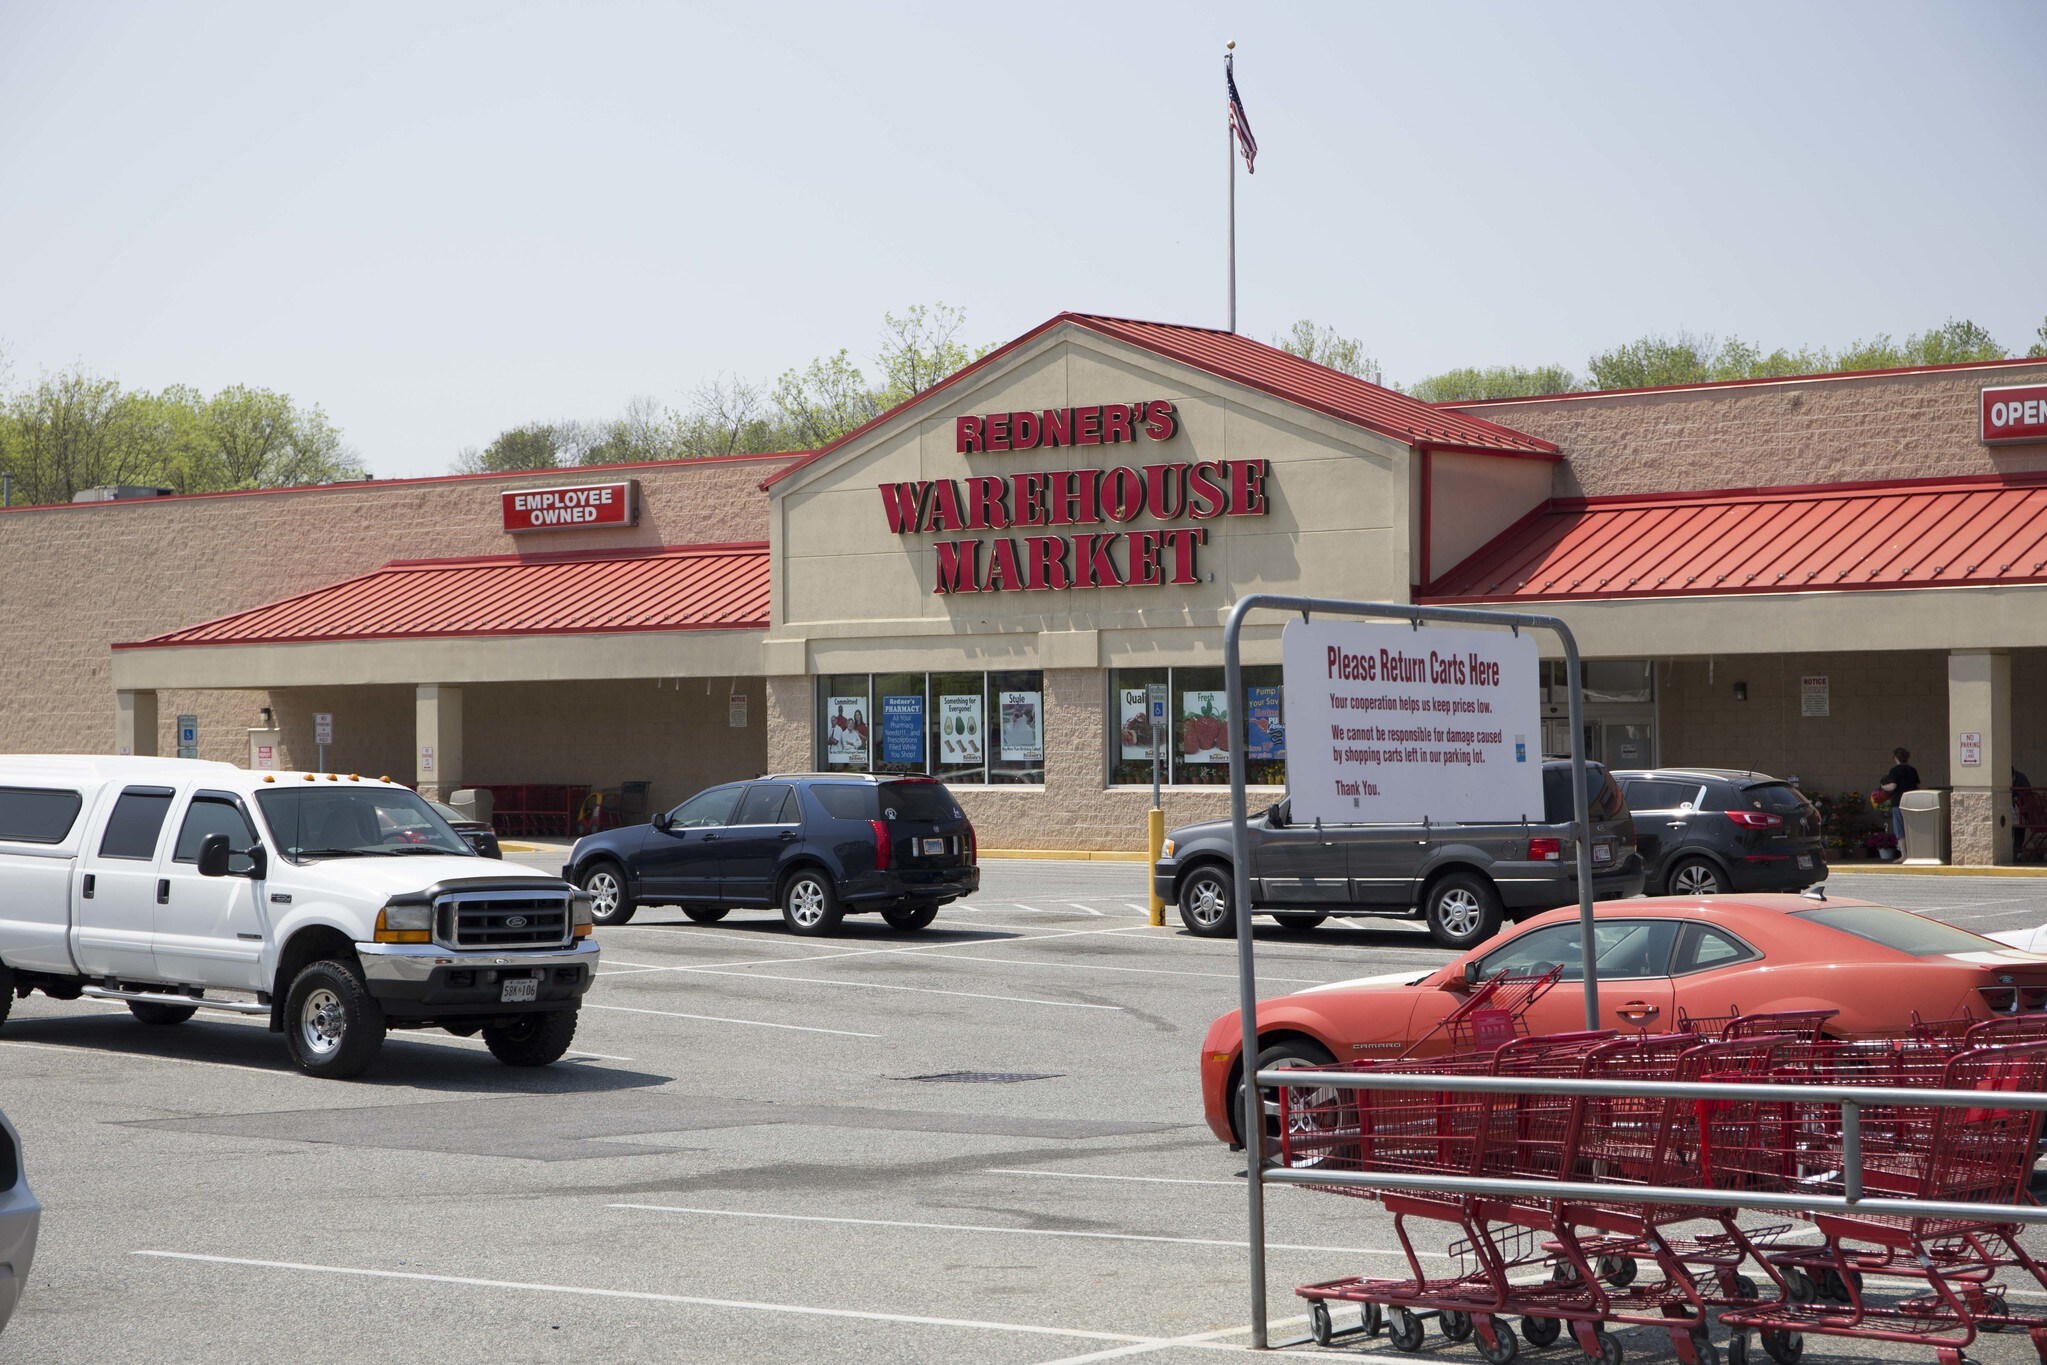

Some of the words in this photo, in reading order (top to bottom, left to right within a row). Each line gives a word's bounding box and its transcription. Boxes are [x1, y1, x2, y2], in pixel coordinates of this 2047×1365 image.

[956, 399, 1176, 454] REDNER'S
[515, 489, 612, 511] EMPLOYEE
[878, 458, 1270, 534] WAREHOUSE
[531, 507, 597, 525] OWNED
[933, 527, 1208, 595] MARKET
[1327, 645, 1377, 682] Please
[1380, 648, 1426, 684] Return
[1430, 650, 1466, 686] Carts
[1469, 653, 1500, 687] Here
[1008, 693, 1026, 704] Style
[1126, 691, 1146, 705] Qual
[1197, 693, 1215, 702] Fresh
[1256, 688, 1276, 696] Pump
[834, 698, 859, 706] Committed
[885, 705, 920, 713] PHARMACY
[944, 697, 969, 706] Something
[948, 705, 972, 713] Everyone!
[1249, 699, 1265, 708] Your
[1266, 697, 1279, 705] Sav
[1329, 693, 1348, 709] Your
[1350, 695, 1398, 713] cooperation
[1399, 696, 1420, 714] helps
[1422, 700, 1431, 711] us
[1432, 697, 1451, 716] keep
[1452, 698, 1475, 716] prices
[1477, 698, 1493, 714] low.
[1331, 724, 1345, 741] We
[1346, 726, 1374, 741] cannot
[1376, 725, 1386, 741] be
[1388, 726, 1432, 745] responsible
[1433, 727, 1445, 742] for
[1446, 728, 1475, 746] damage
[1476, 729, 1502, 743] caused
[1333, 746, 1343, 765] by
[1344, 746, 1382, 765] shopping
[1383, 747, 1404, 762] carts
[1404, 747, 1419, 762] left
[1420, 748, 1428, 763] in
[1429, 750, 1442, 763] our
[1443, 748, 1472, 767] parking
[1473, 748, 1486, 764] lot.
[1335, 780, 1361, 796] Thank
[1362, 780, 1381, 796] You.
